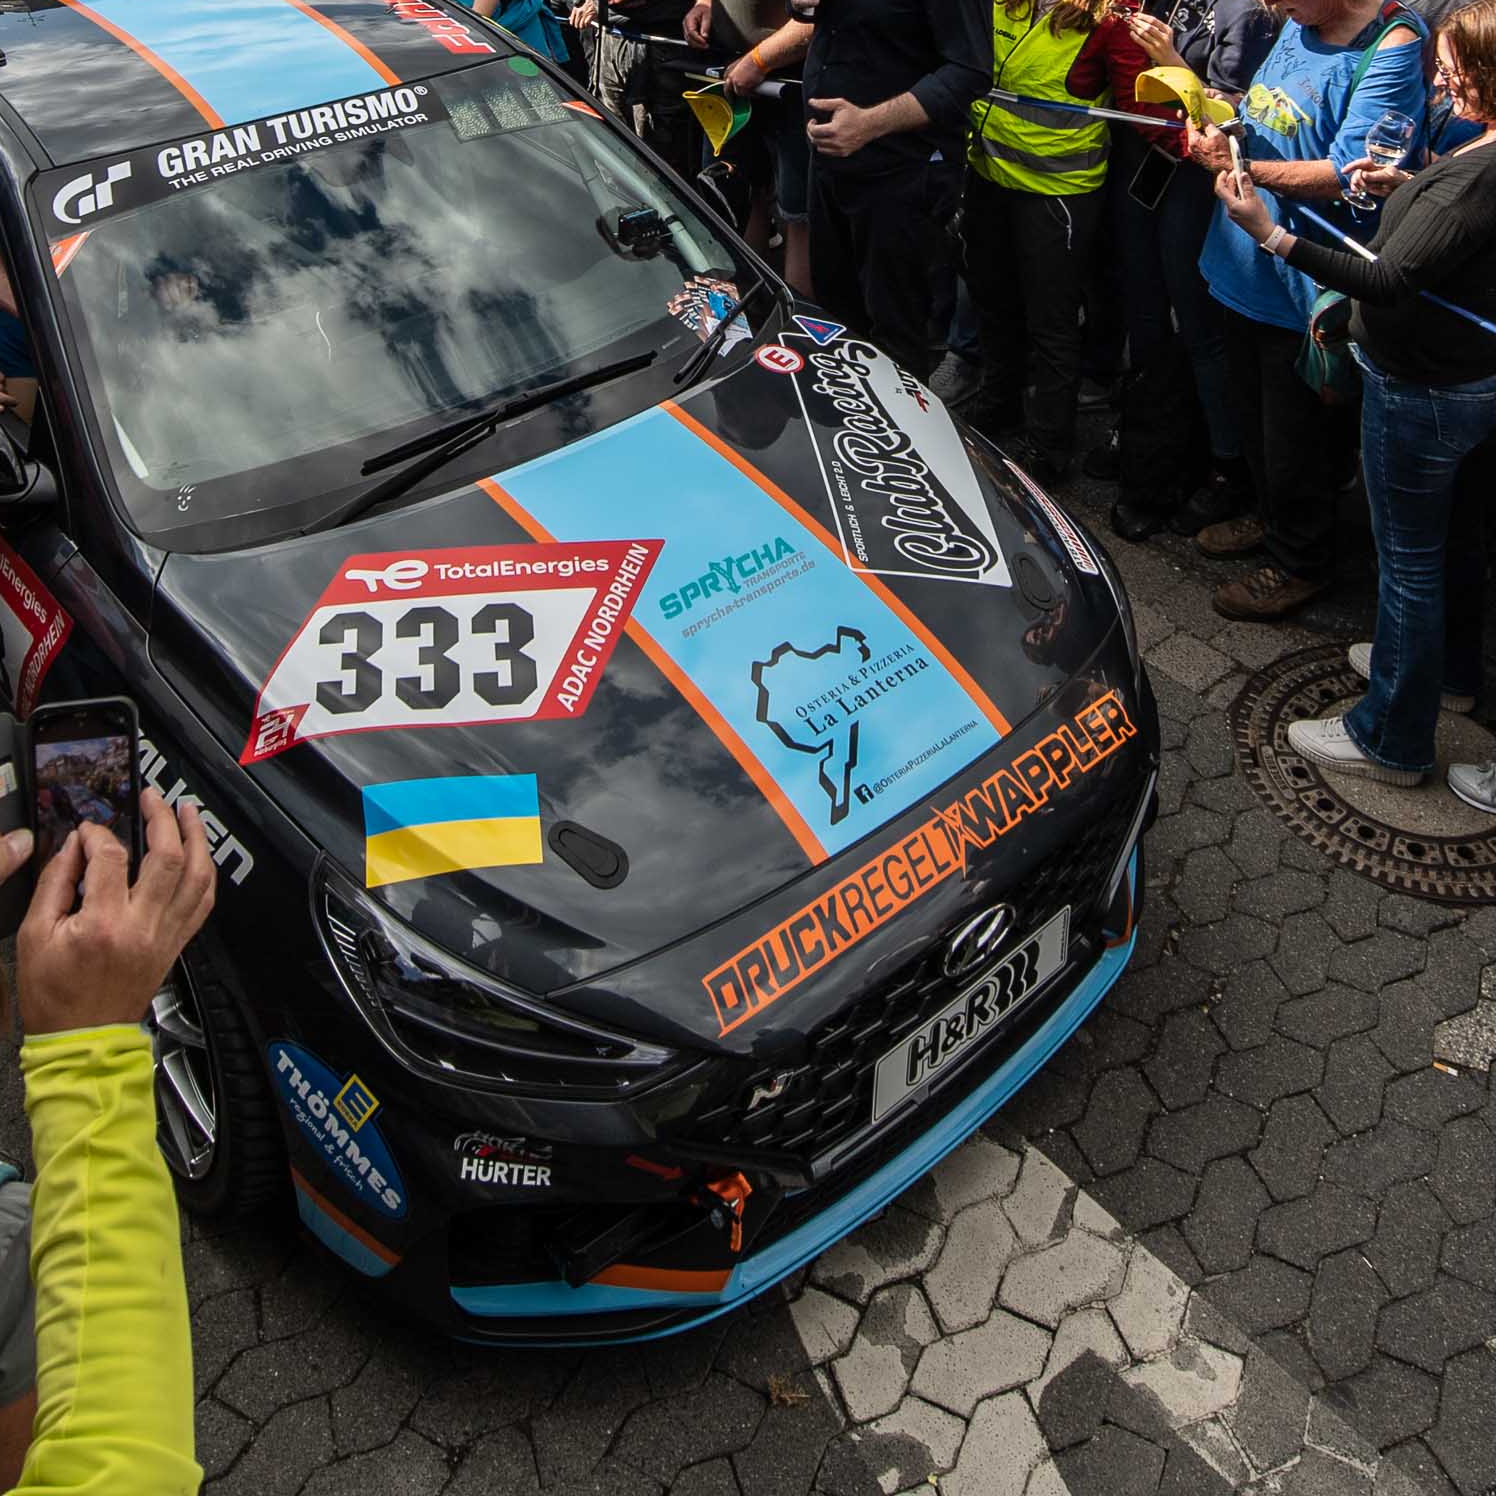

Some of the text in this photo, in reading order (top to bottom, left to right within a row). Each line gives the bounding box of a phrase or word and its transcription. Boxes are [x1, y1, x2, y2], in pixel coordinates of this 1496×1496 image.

[158, 126, 263, 179] GRAN
[168, 111, 429, 190] THE REAL DRIVING SIMULATOR
[766, 350, 793, 369] E
[837, 474, 851, 502] LEICHT
[435, 557, 609, 581] TotalEnergies
[743, 551, 806, 589] TRANSPORTE
[851, 514, 868, 562] SPORTLICH
[659, 536, 798, 620] SPRYCHA
[682, 560, 816, 639] sprycha-transporte.de
[316, 602, 539, 715] 333
[557, 542, 649, 712] ADAC NORDRHEIN
[794, 643, 916, 720] OSTERIA & PIZZERIA
[803, 655, 930, 736] La Lanterna
[906, 976, 1001, 1086] H&R
[277, 1049, 401, 1210] THÖMMES
[289, 1097, 363, 1191] regional & frisch
